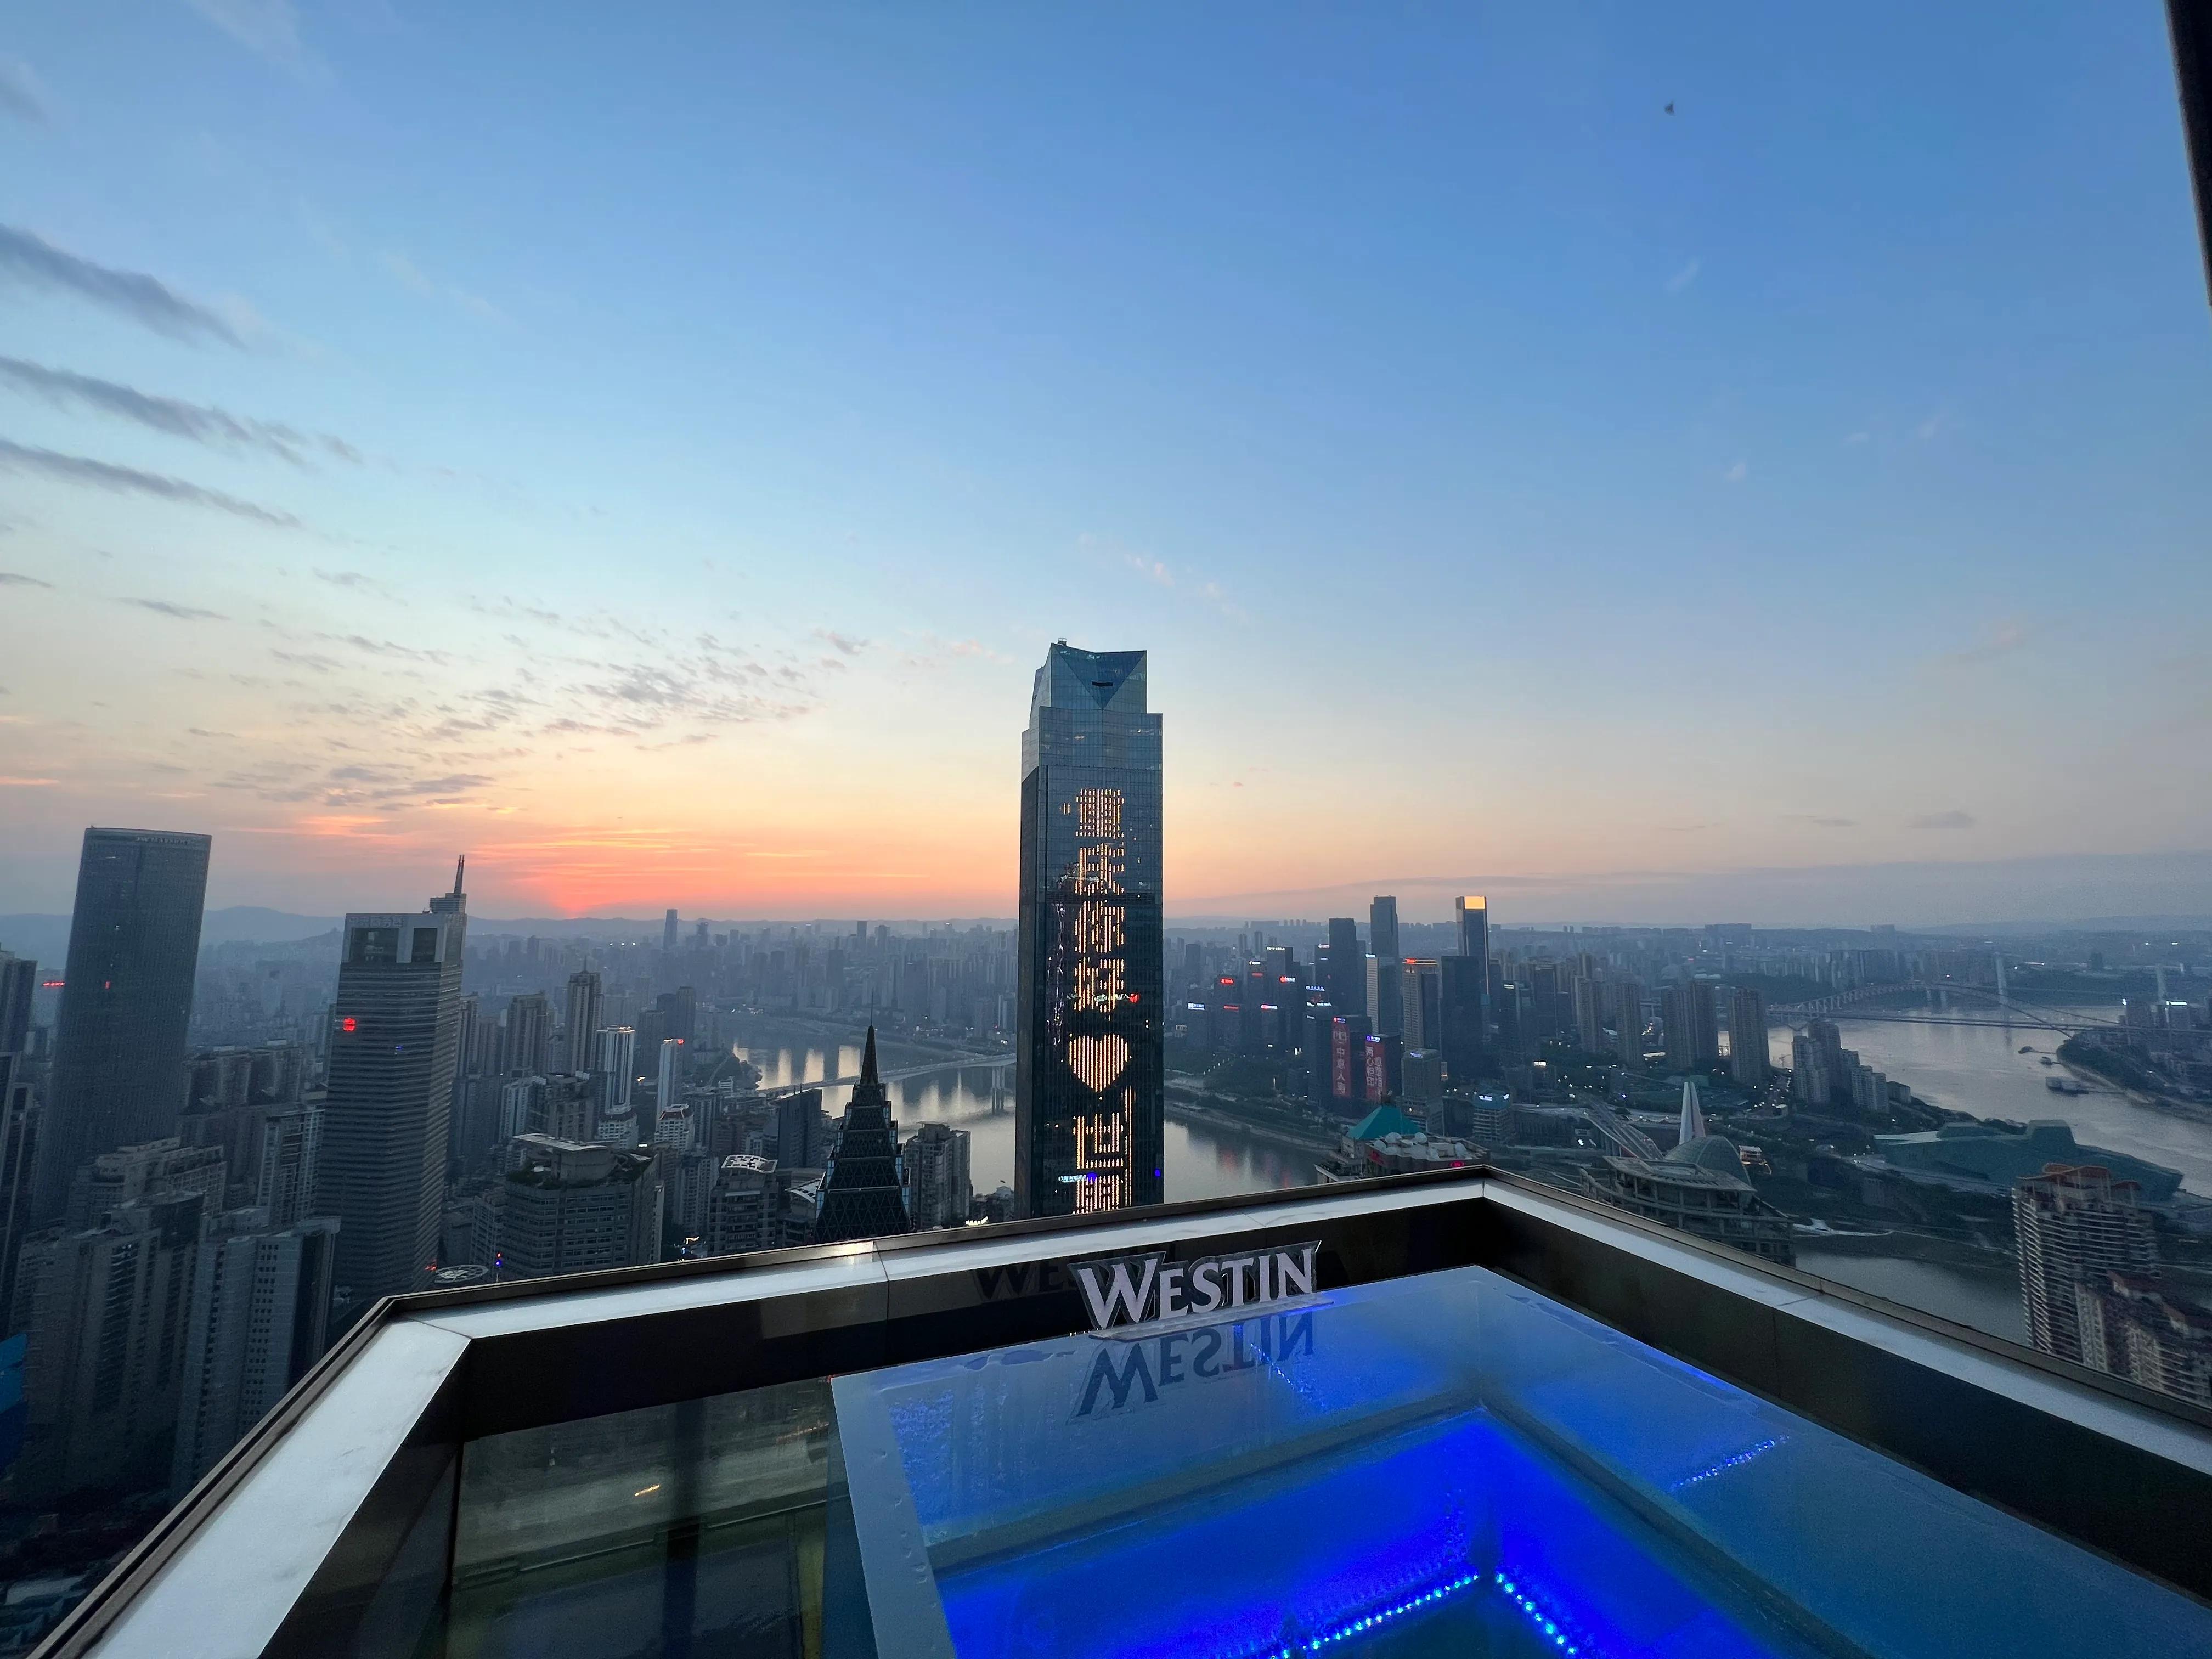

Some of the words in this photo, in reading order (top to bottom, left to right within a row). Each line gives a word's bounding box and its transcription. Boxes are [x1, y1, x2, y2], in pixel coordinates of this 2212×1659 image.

[1074, 788, 1125, 1012] 重庆你好
[1077, 1248, 1314, 1329] WESTIN
